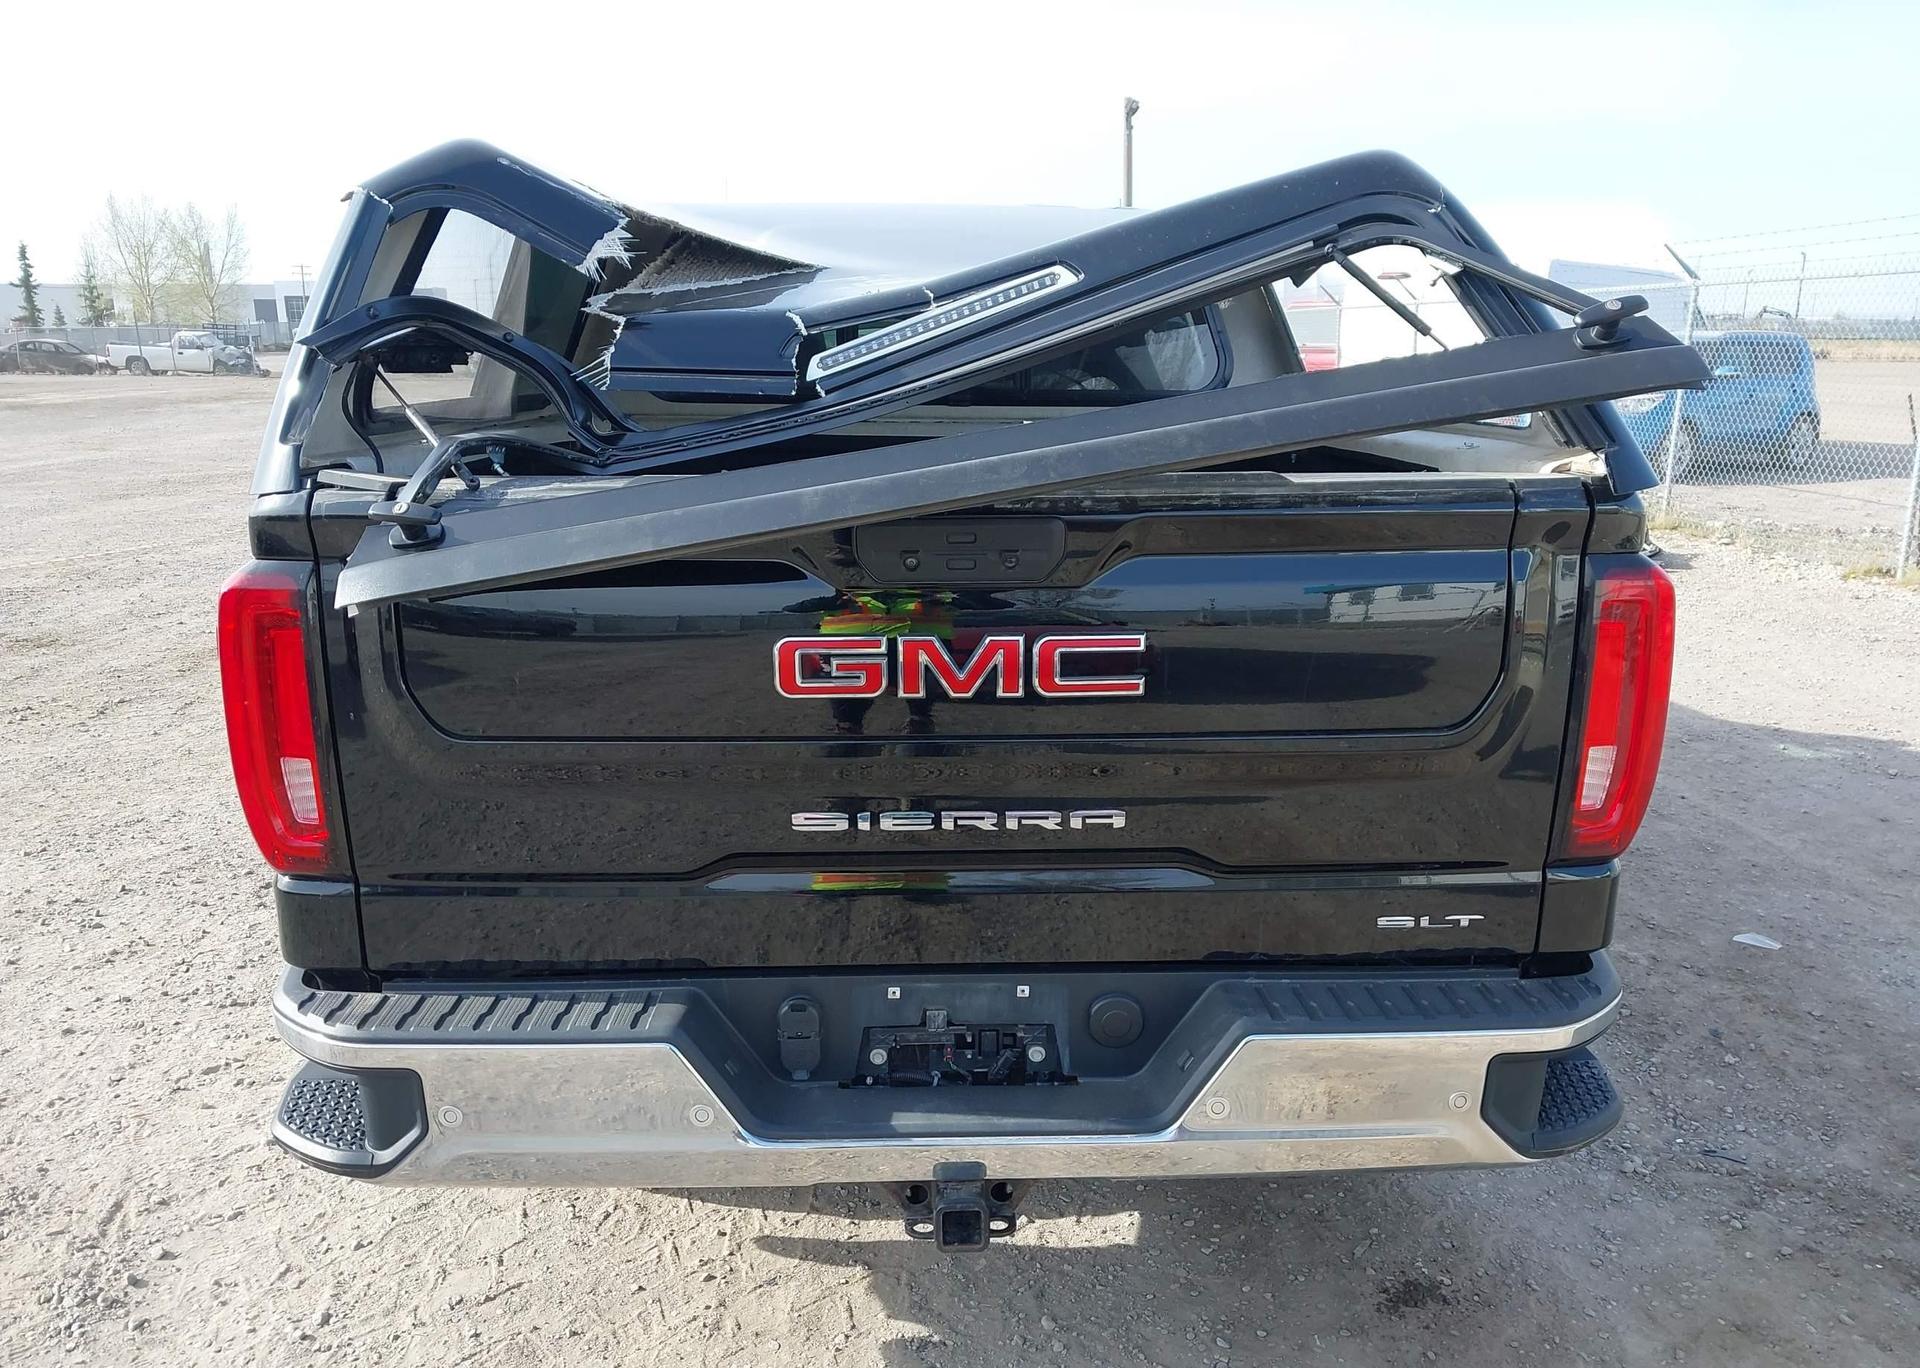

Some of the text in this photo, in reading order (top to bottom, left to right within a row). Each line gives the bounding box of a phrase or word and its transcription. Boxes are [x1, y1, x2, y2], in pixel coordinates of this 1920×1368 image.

[773, 633, 1147, 699] GMC
[790, 809, 1127, 832] SIERRA
[1376, 914, 1486, 928] SLT
